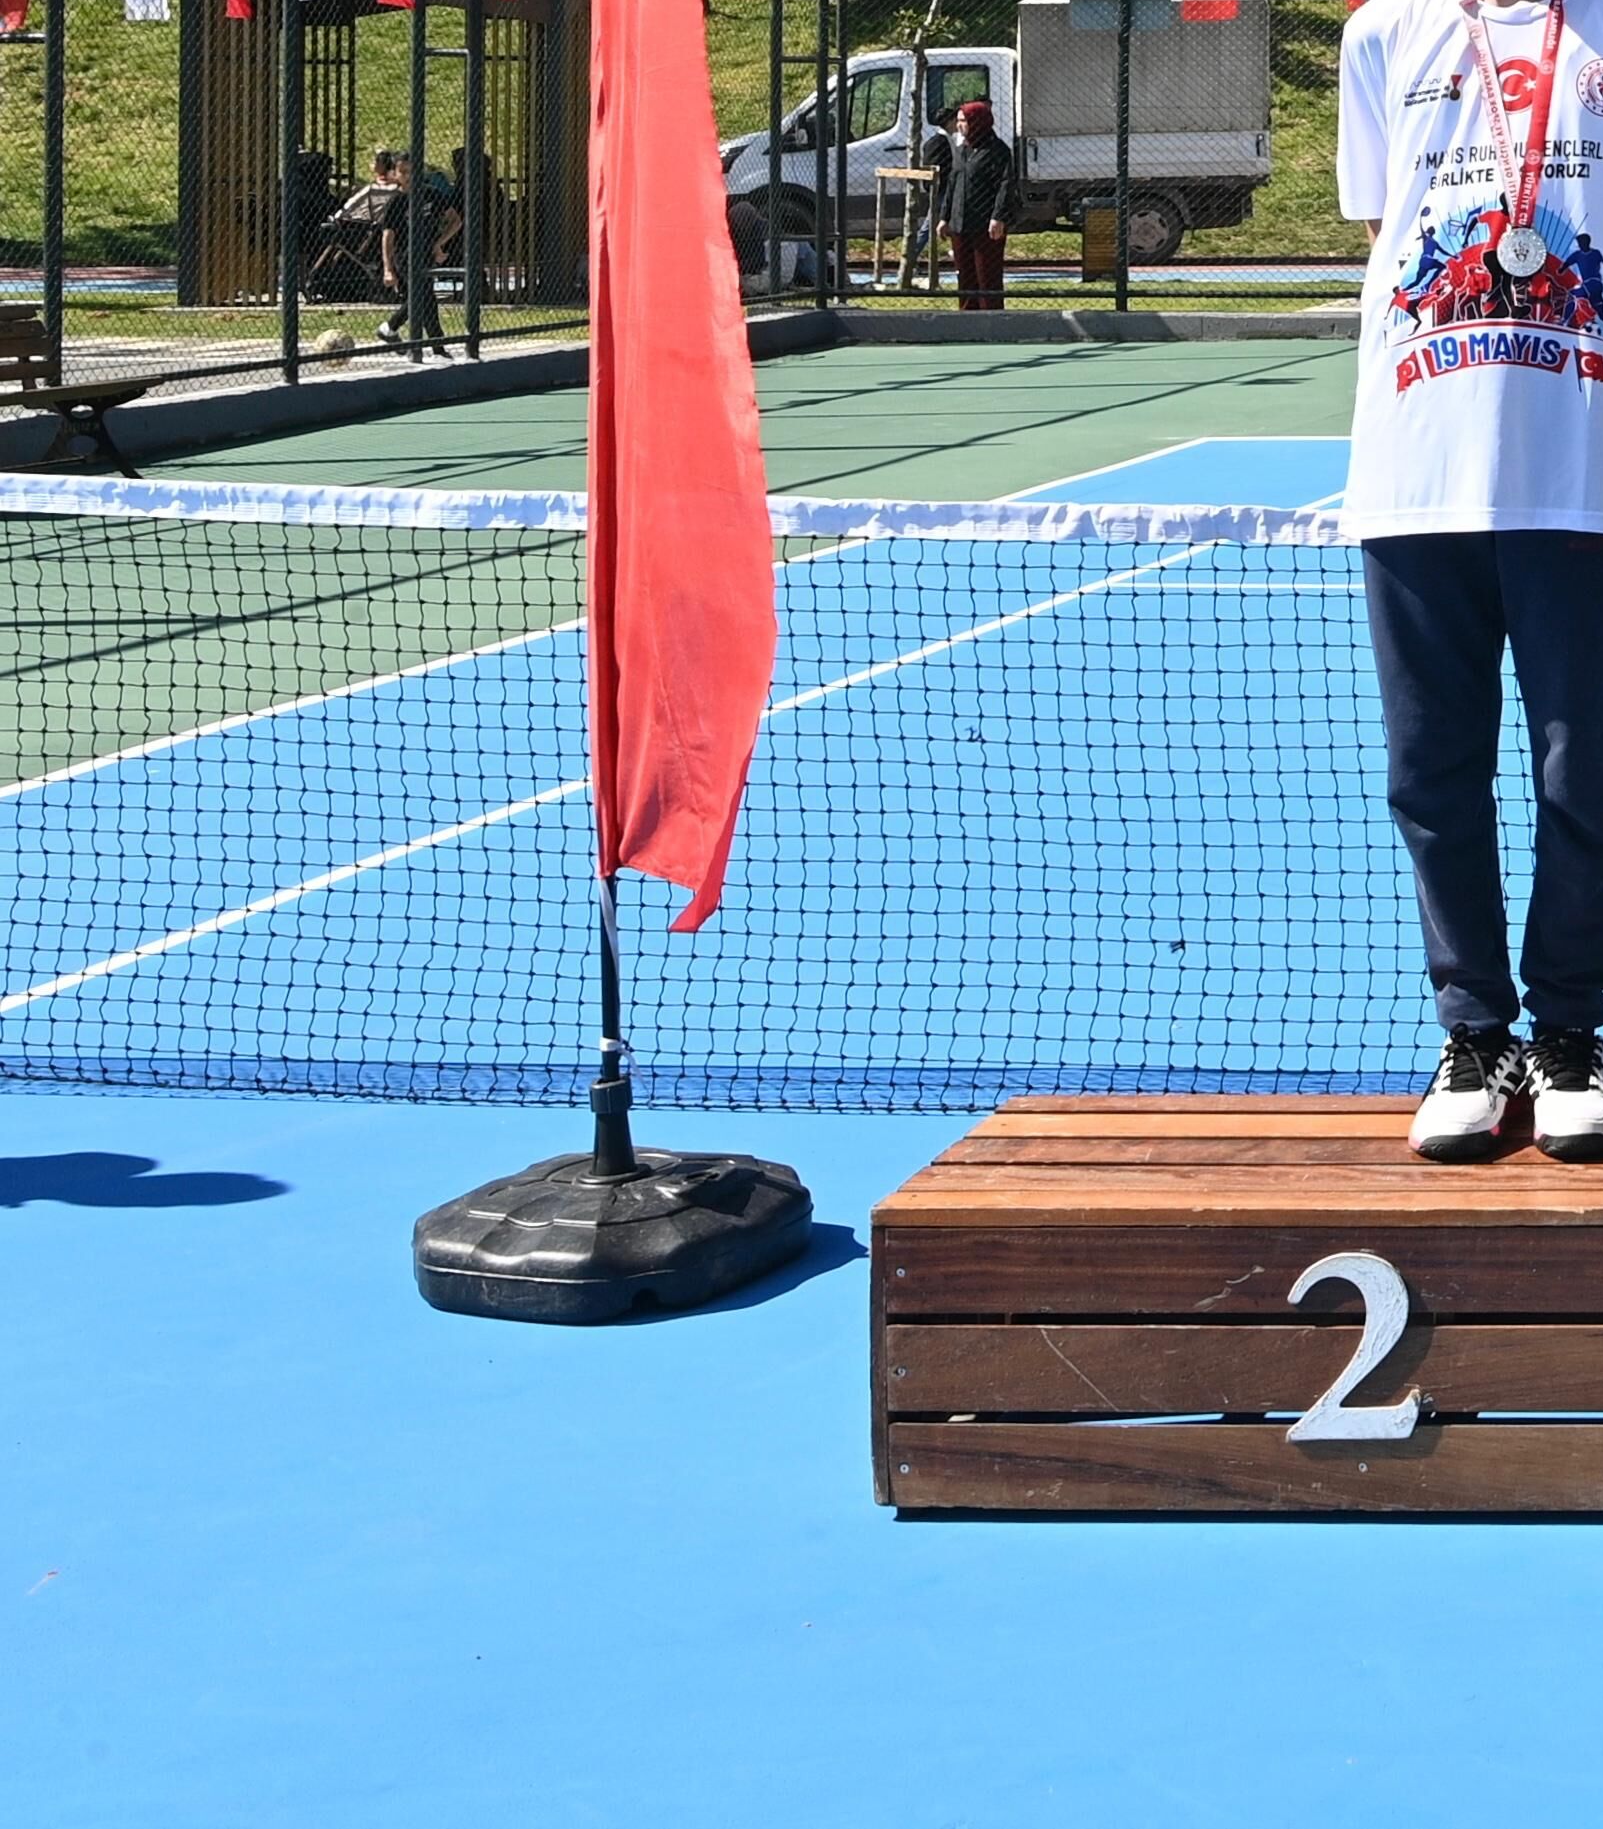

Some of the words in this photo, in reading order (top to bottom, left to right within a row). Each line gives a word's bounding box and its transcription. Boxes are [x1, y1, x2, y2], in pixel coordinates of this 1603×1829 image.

[1427, 335, 1460, 370] 19
[1468, 332, 1562, 366] MAYIS
[1285, 1251, 1422, 1443] 2
